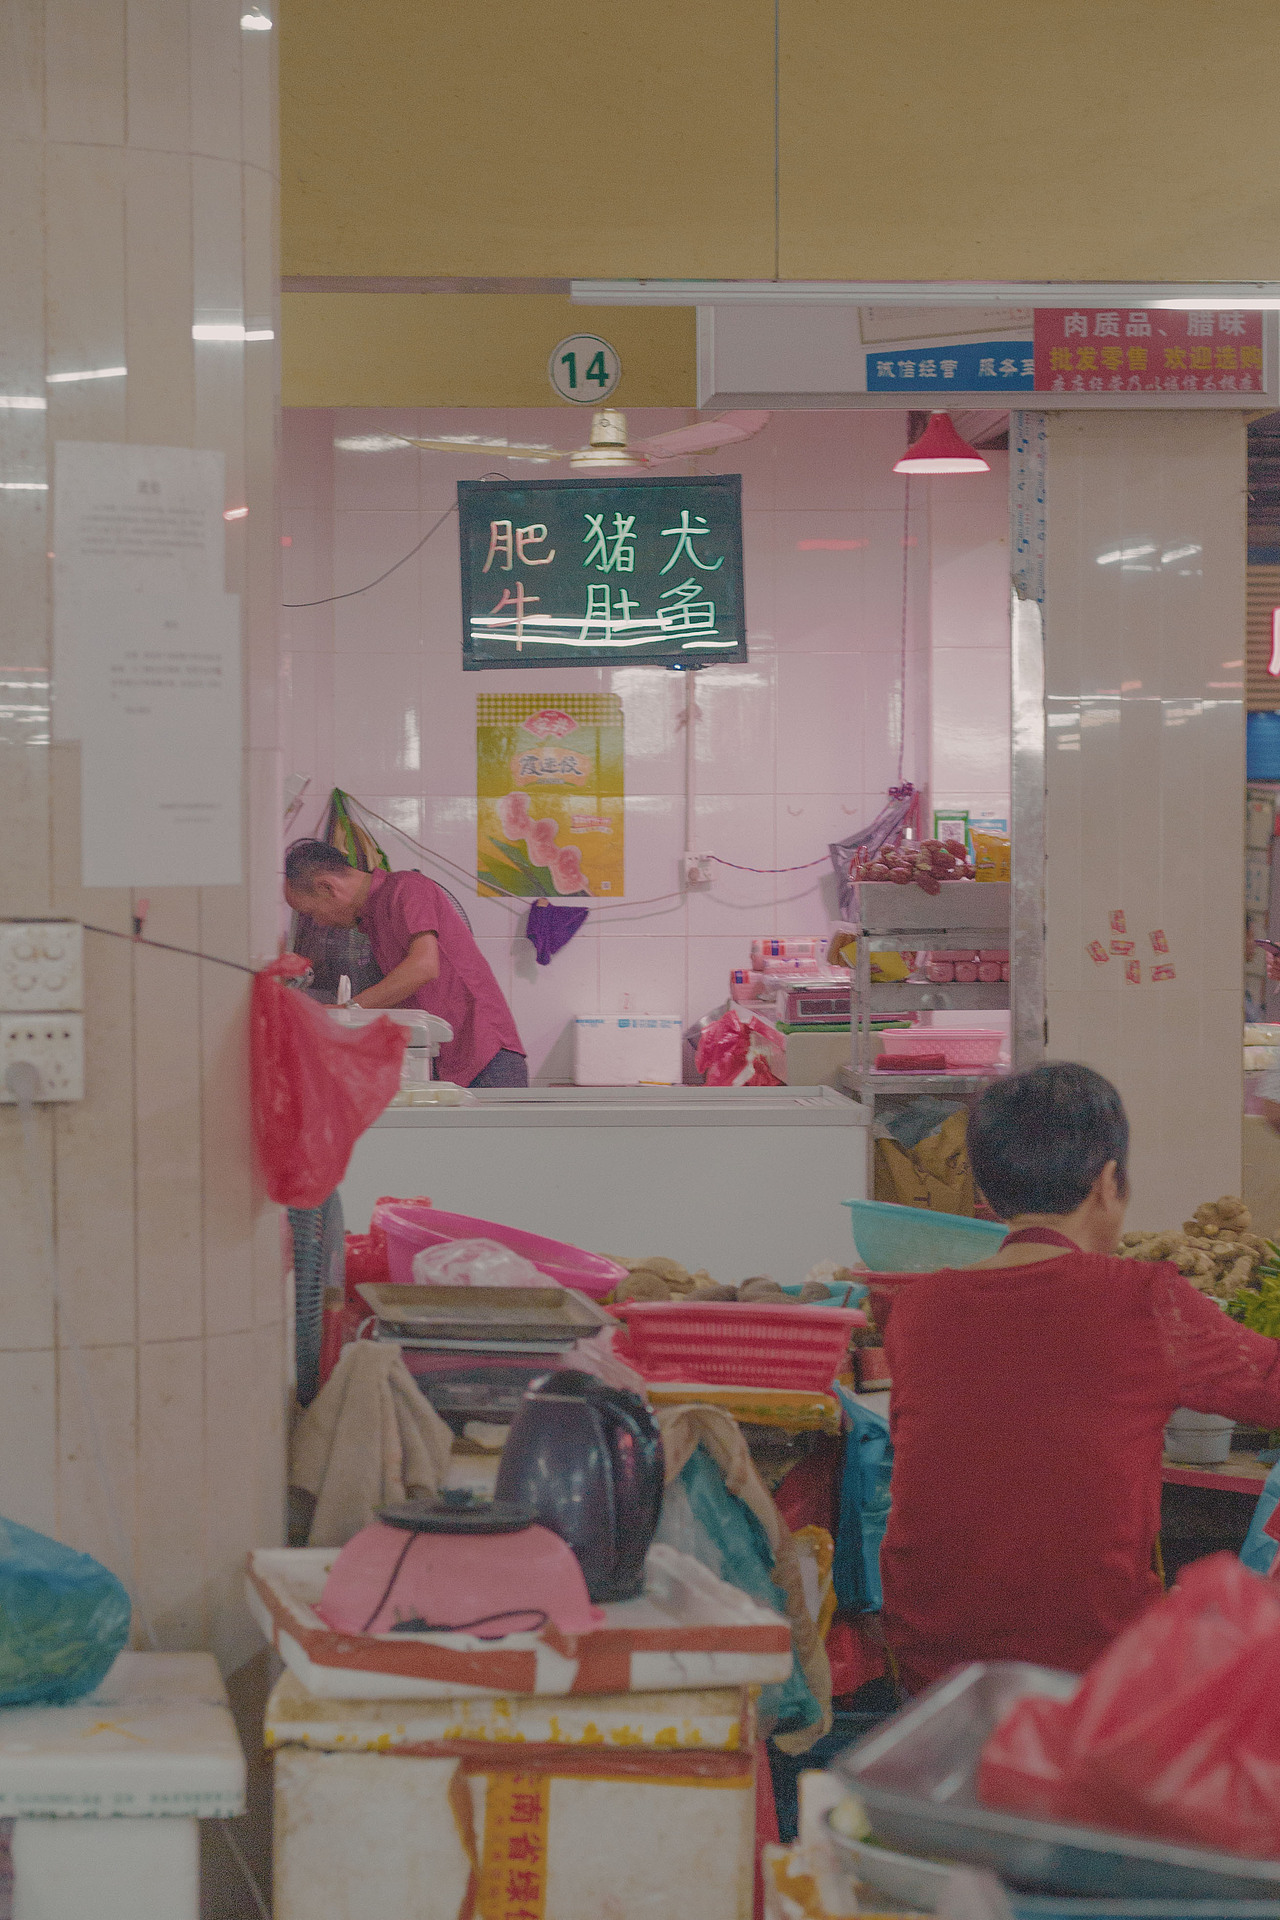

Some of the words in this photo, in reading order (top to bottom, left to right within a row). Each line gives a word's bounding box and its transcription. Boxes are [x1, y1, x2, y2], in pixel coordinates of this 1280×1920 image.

[561, 350, 609, 389] 14
[1049, 346, 1148, 371] 批发零售
